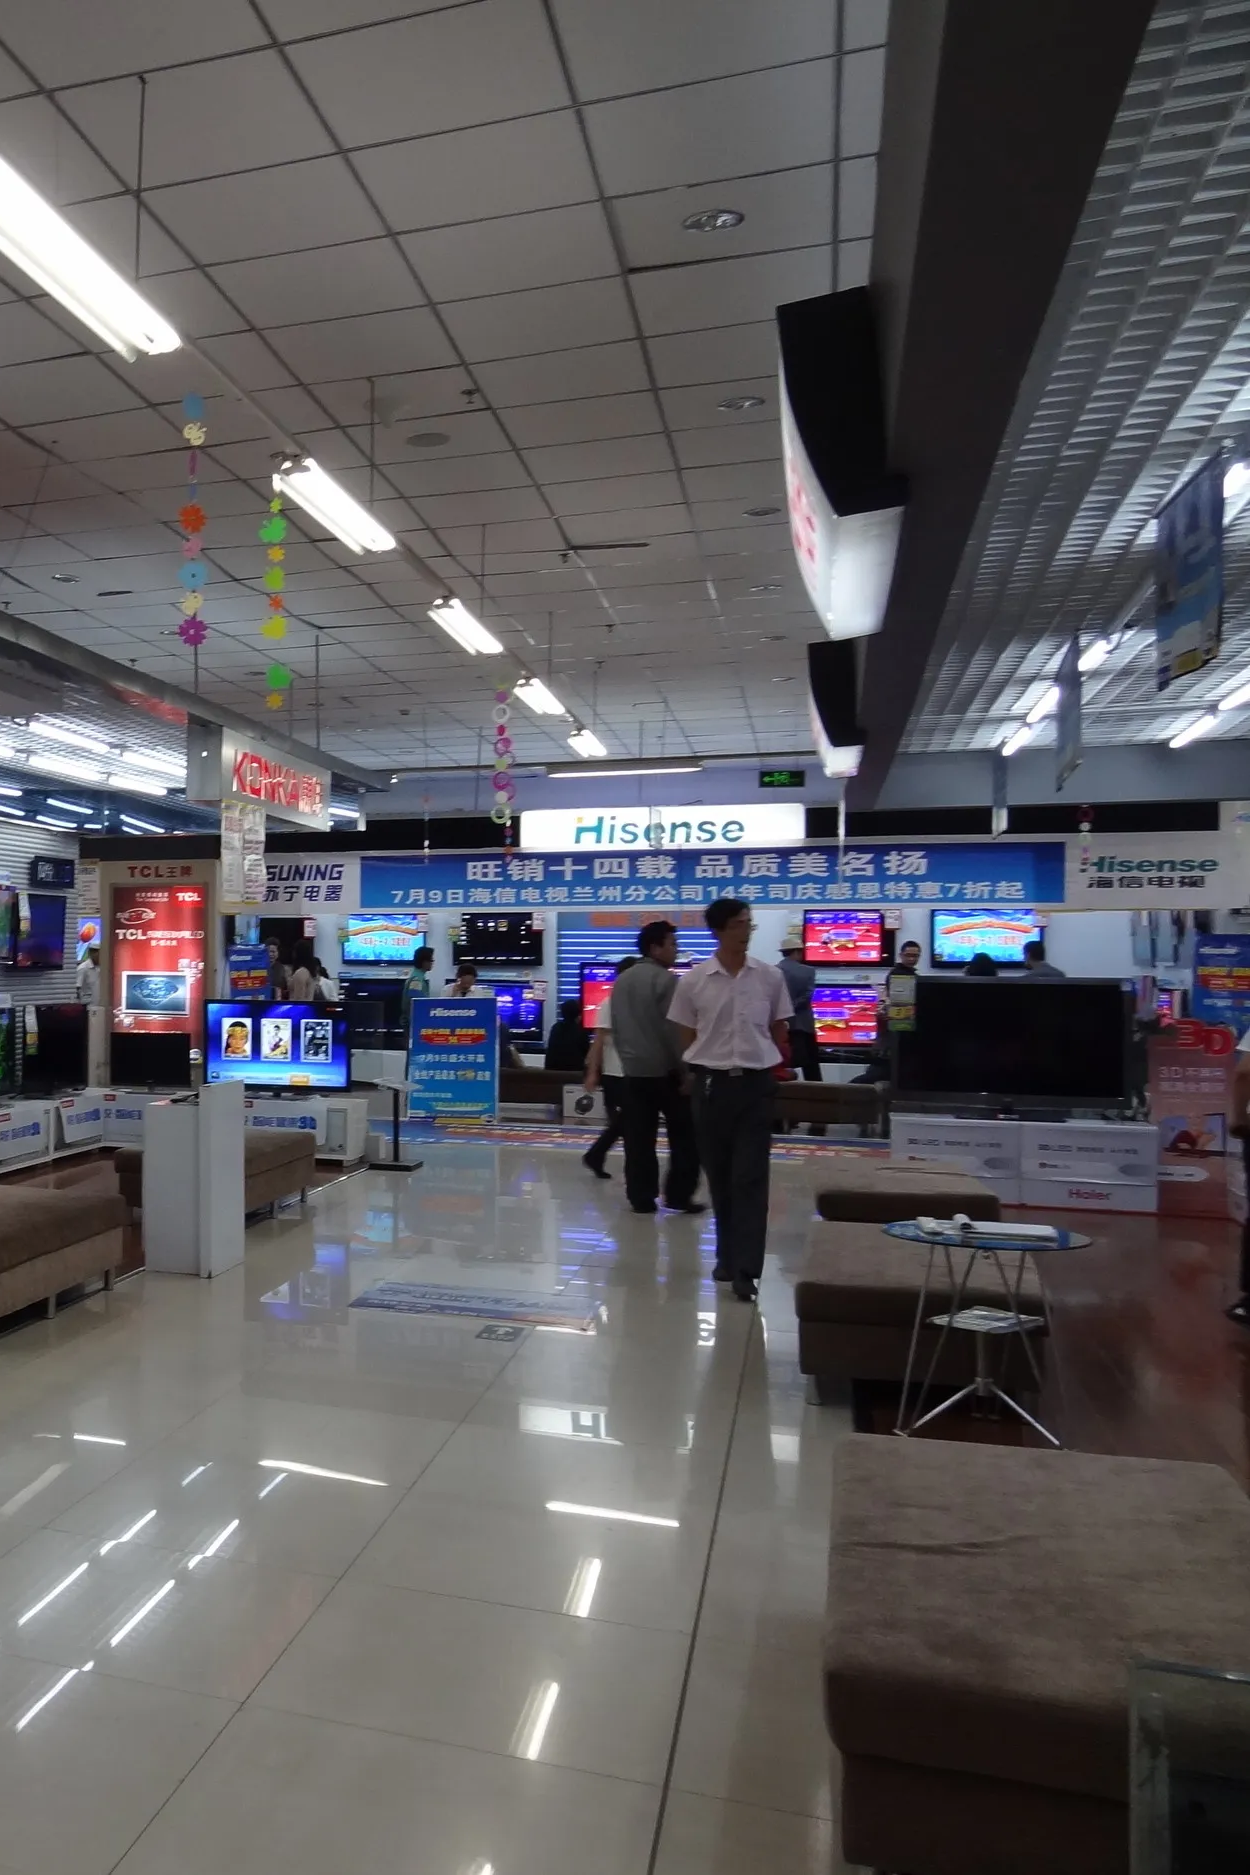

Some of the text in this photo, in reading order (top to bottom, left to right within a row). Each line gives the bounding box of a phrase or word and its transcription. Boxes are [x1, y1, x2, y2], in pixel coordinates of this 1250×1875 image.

[232, 749, 299, 808] KONKA
[574, 816, 745, 845] Hisense
[265, 864, 345, 882] SUNING
[466, 851, 928, 882] 旺销十四载 品质美名扬
[1080, 855, 1220, 873] Hisense
[175, 892, 202, 902] TCL
[261, 884, 343, 902] 苏宁电器
[115, 929, 148, 940] TCL
[1176, 1018, 1234, 1056] 3D
[1068, 1188, 1111, 1200] Haier
